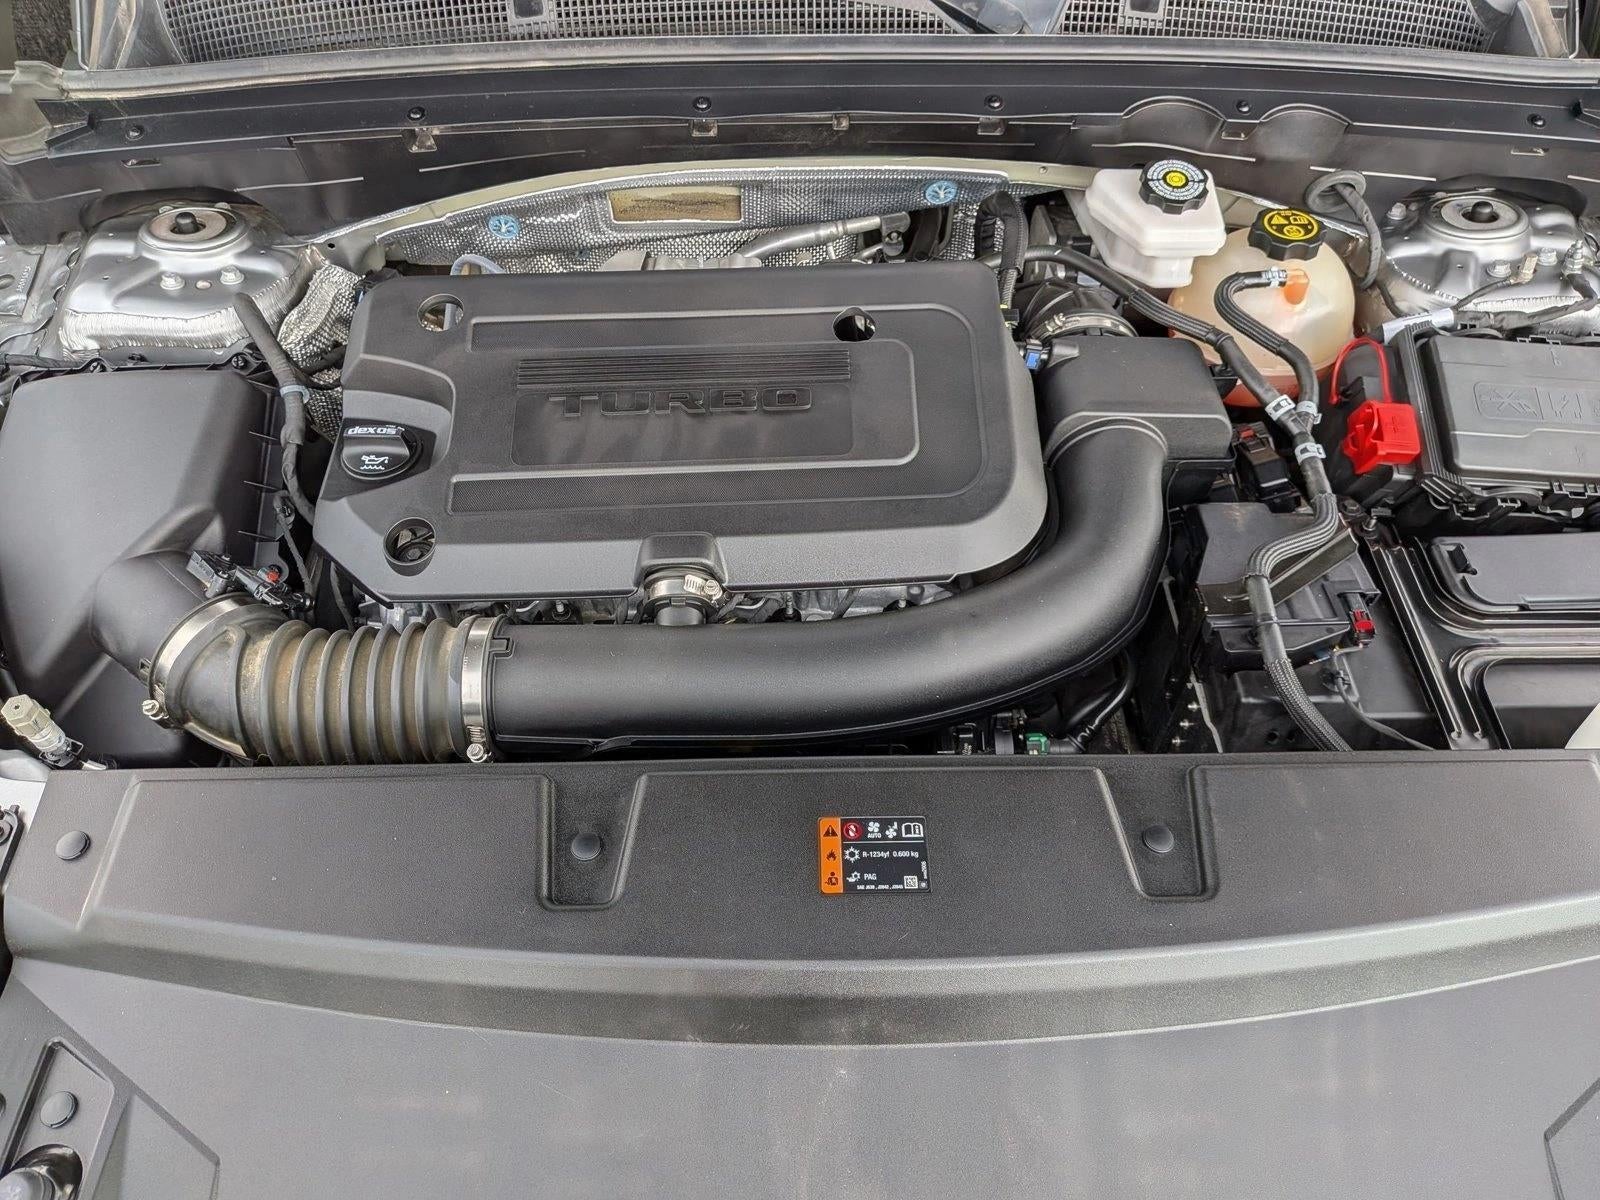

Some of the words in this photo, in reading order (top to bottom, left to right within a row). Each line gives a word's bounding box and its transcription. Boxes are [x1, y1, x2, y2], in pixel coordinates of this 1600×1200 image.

[549, 387, 812, 417] TURBO
[347, 425, 397, 435] dexos
[862, 851, 890, 859] R-1234yf
[892, 850, 910, 858] 0.600
[910, 850, 919, 859] kg
[863, 873, 877, 881] PAG
